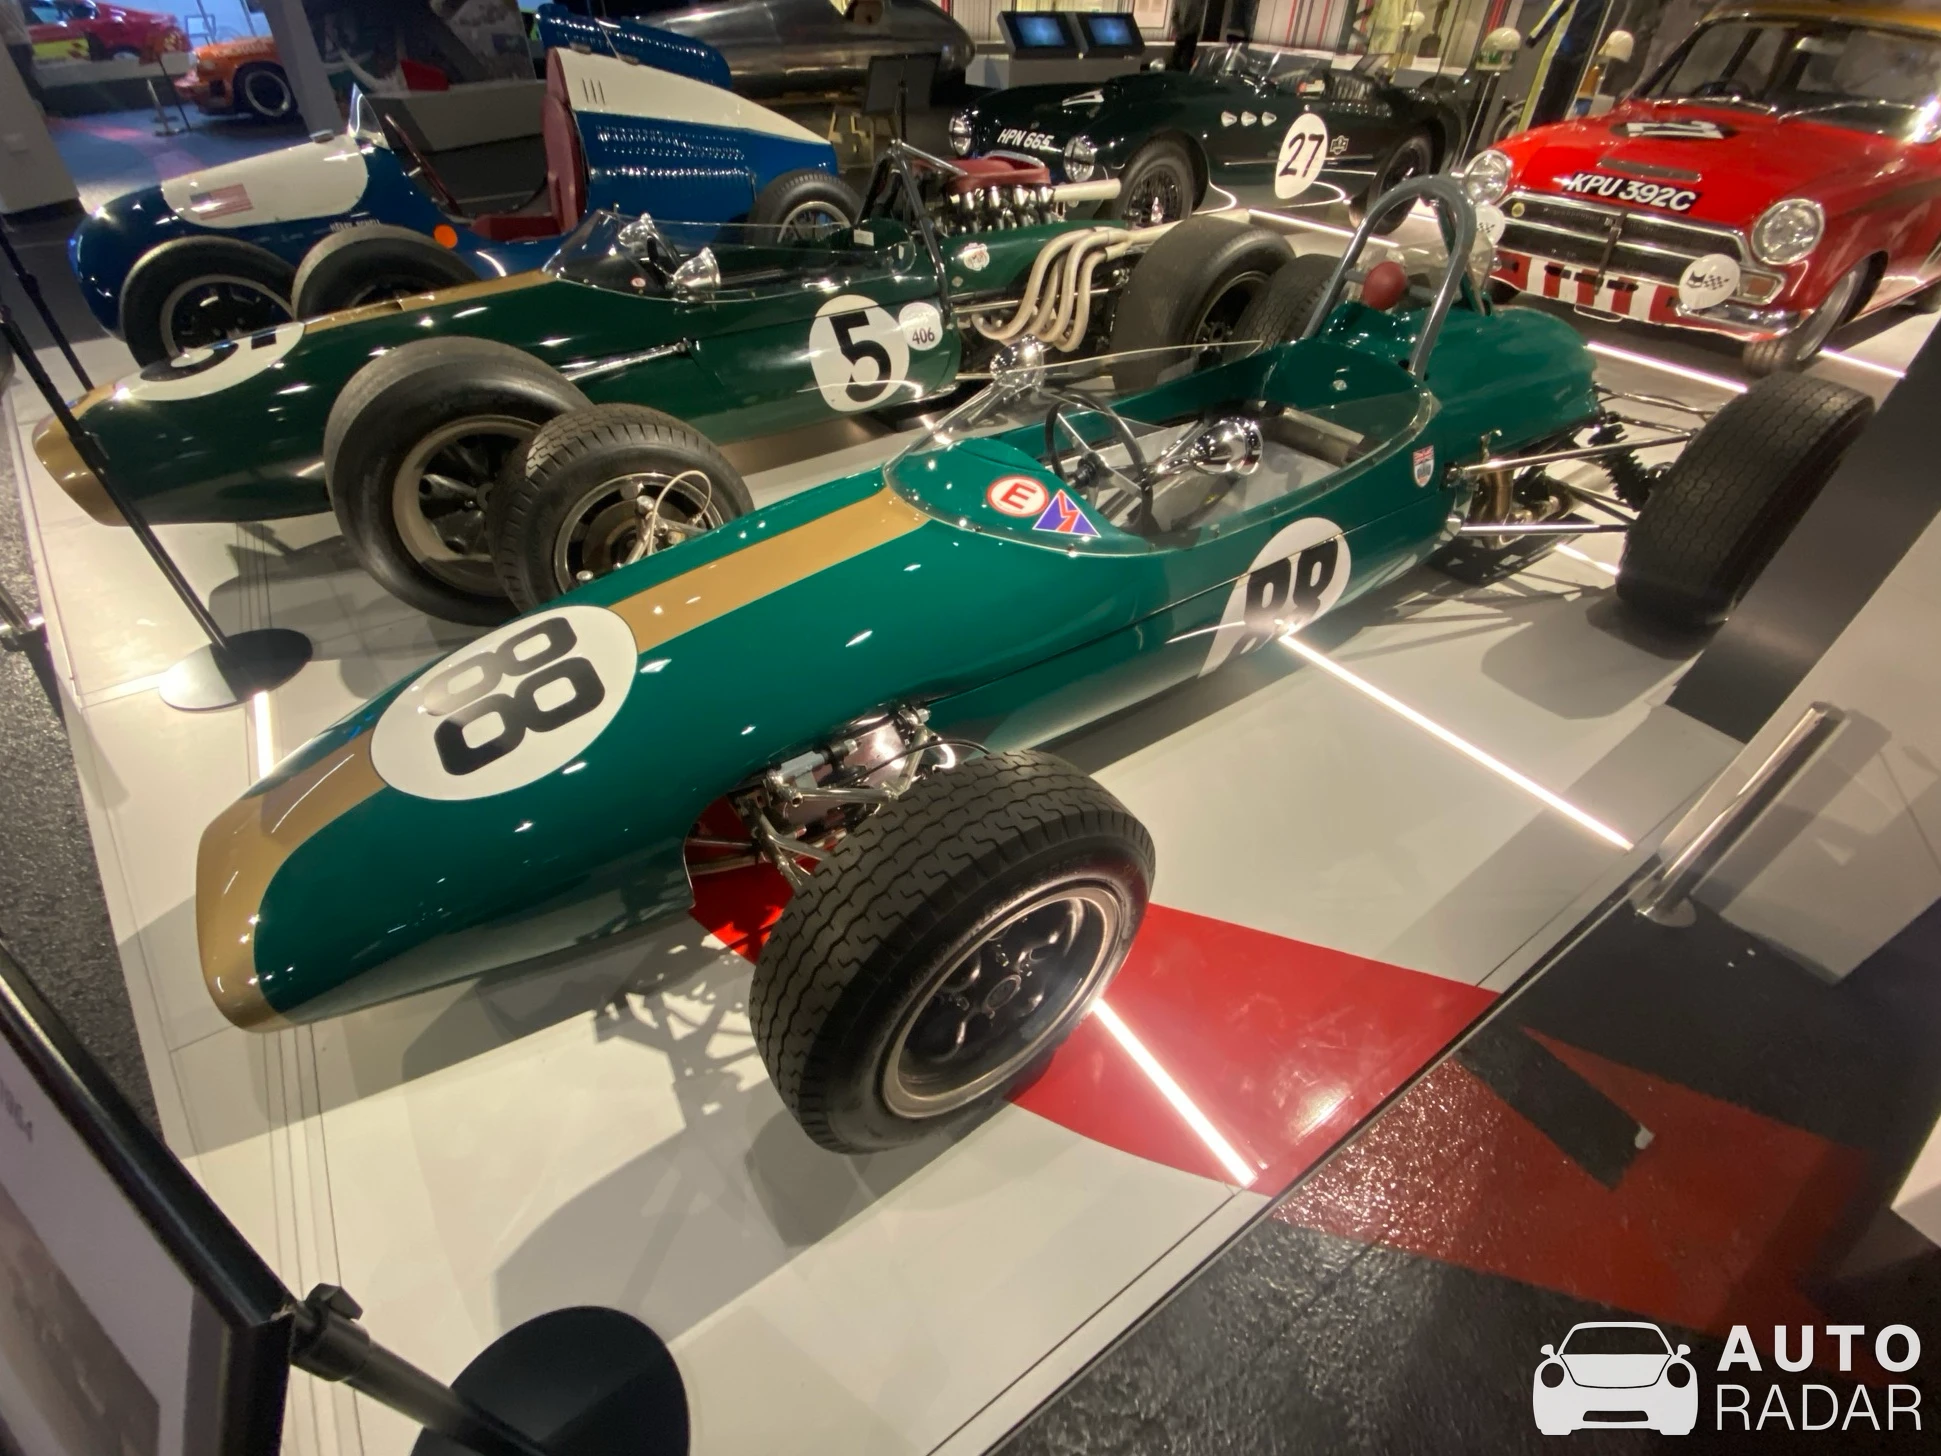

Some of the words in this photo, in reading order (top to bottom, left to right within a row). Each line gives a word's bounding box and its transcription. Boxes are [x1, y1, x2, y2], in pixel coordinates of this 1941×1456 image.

[997, 128, 1027, 146] HPN
[1023, 132, 1055, 150] 665
[1279, 131, 1325, 178] 27
[1567, 173, 1623, 196] KPU
[1619, 180, 1697, 211] 392C
[912, 327, 935, 345] 406
[828, 310, 892, 403] 5
[1000, 482, 1038, 510] E
[422, 616, 606, 776] 88
